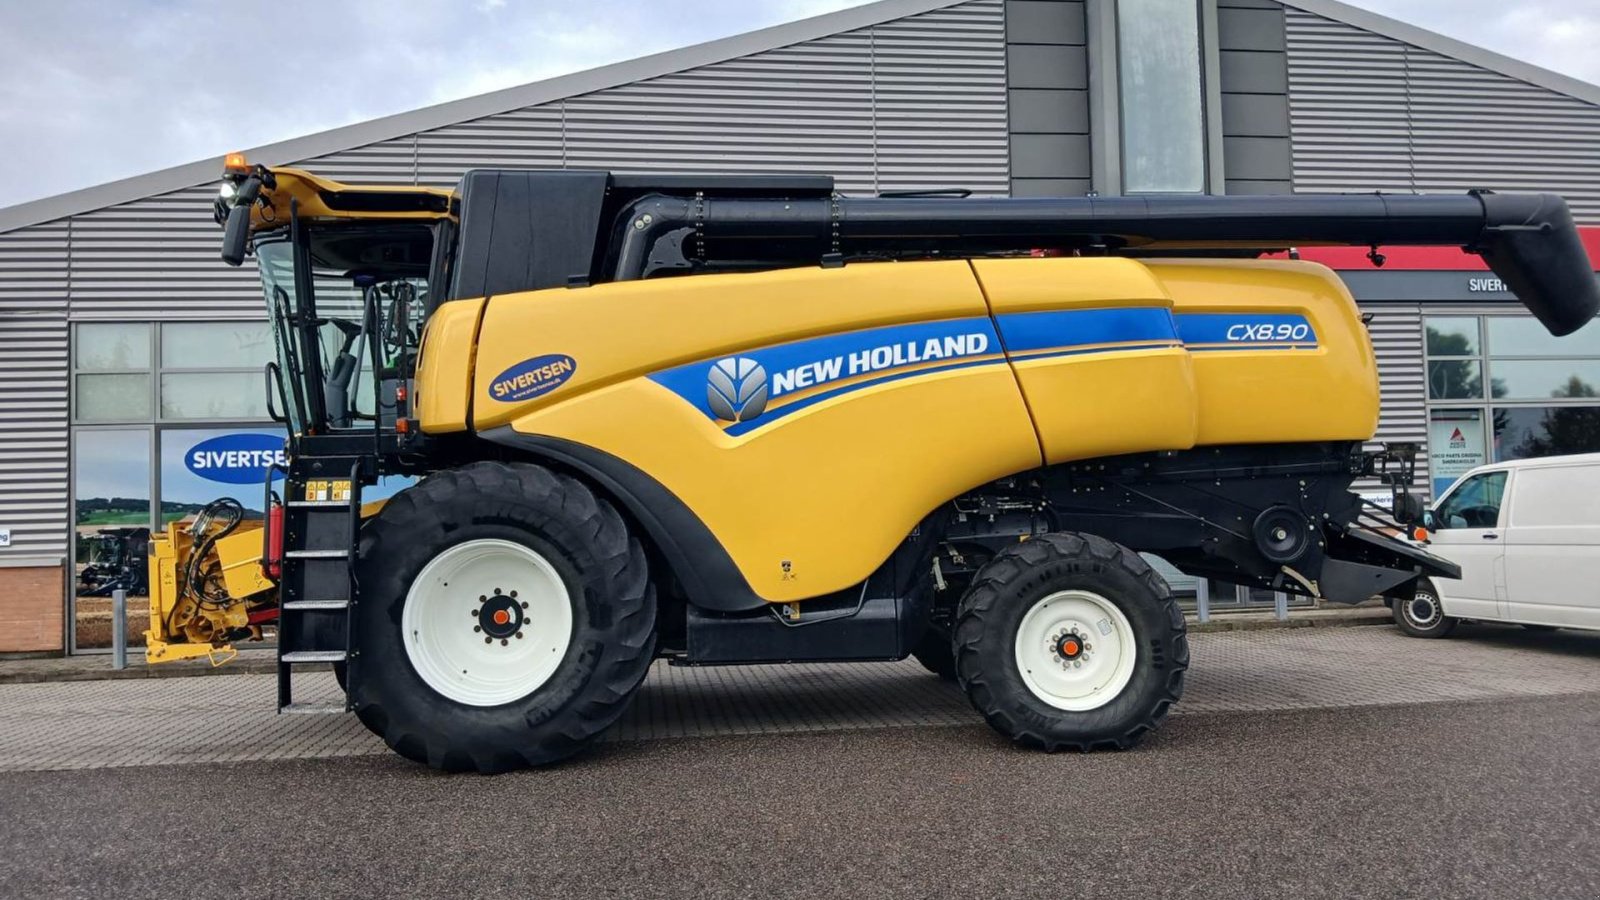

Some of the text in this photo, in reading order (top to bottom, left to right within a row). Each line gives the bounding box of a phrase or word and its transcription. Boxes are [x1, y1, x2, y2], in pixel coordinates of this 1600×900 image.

[1227, 324, 1308, 340] CX8.90
[494, 359, 572, 397] SIVERTSEN
[773, 333, 988, 395] NEW HOLLAND
[193, 450, 291, 469] SIVERTSE
